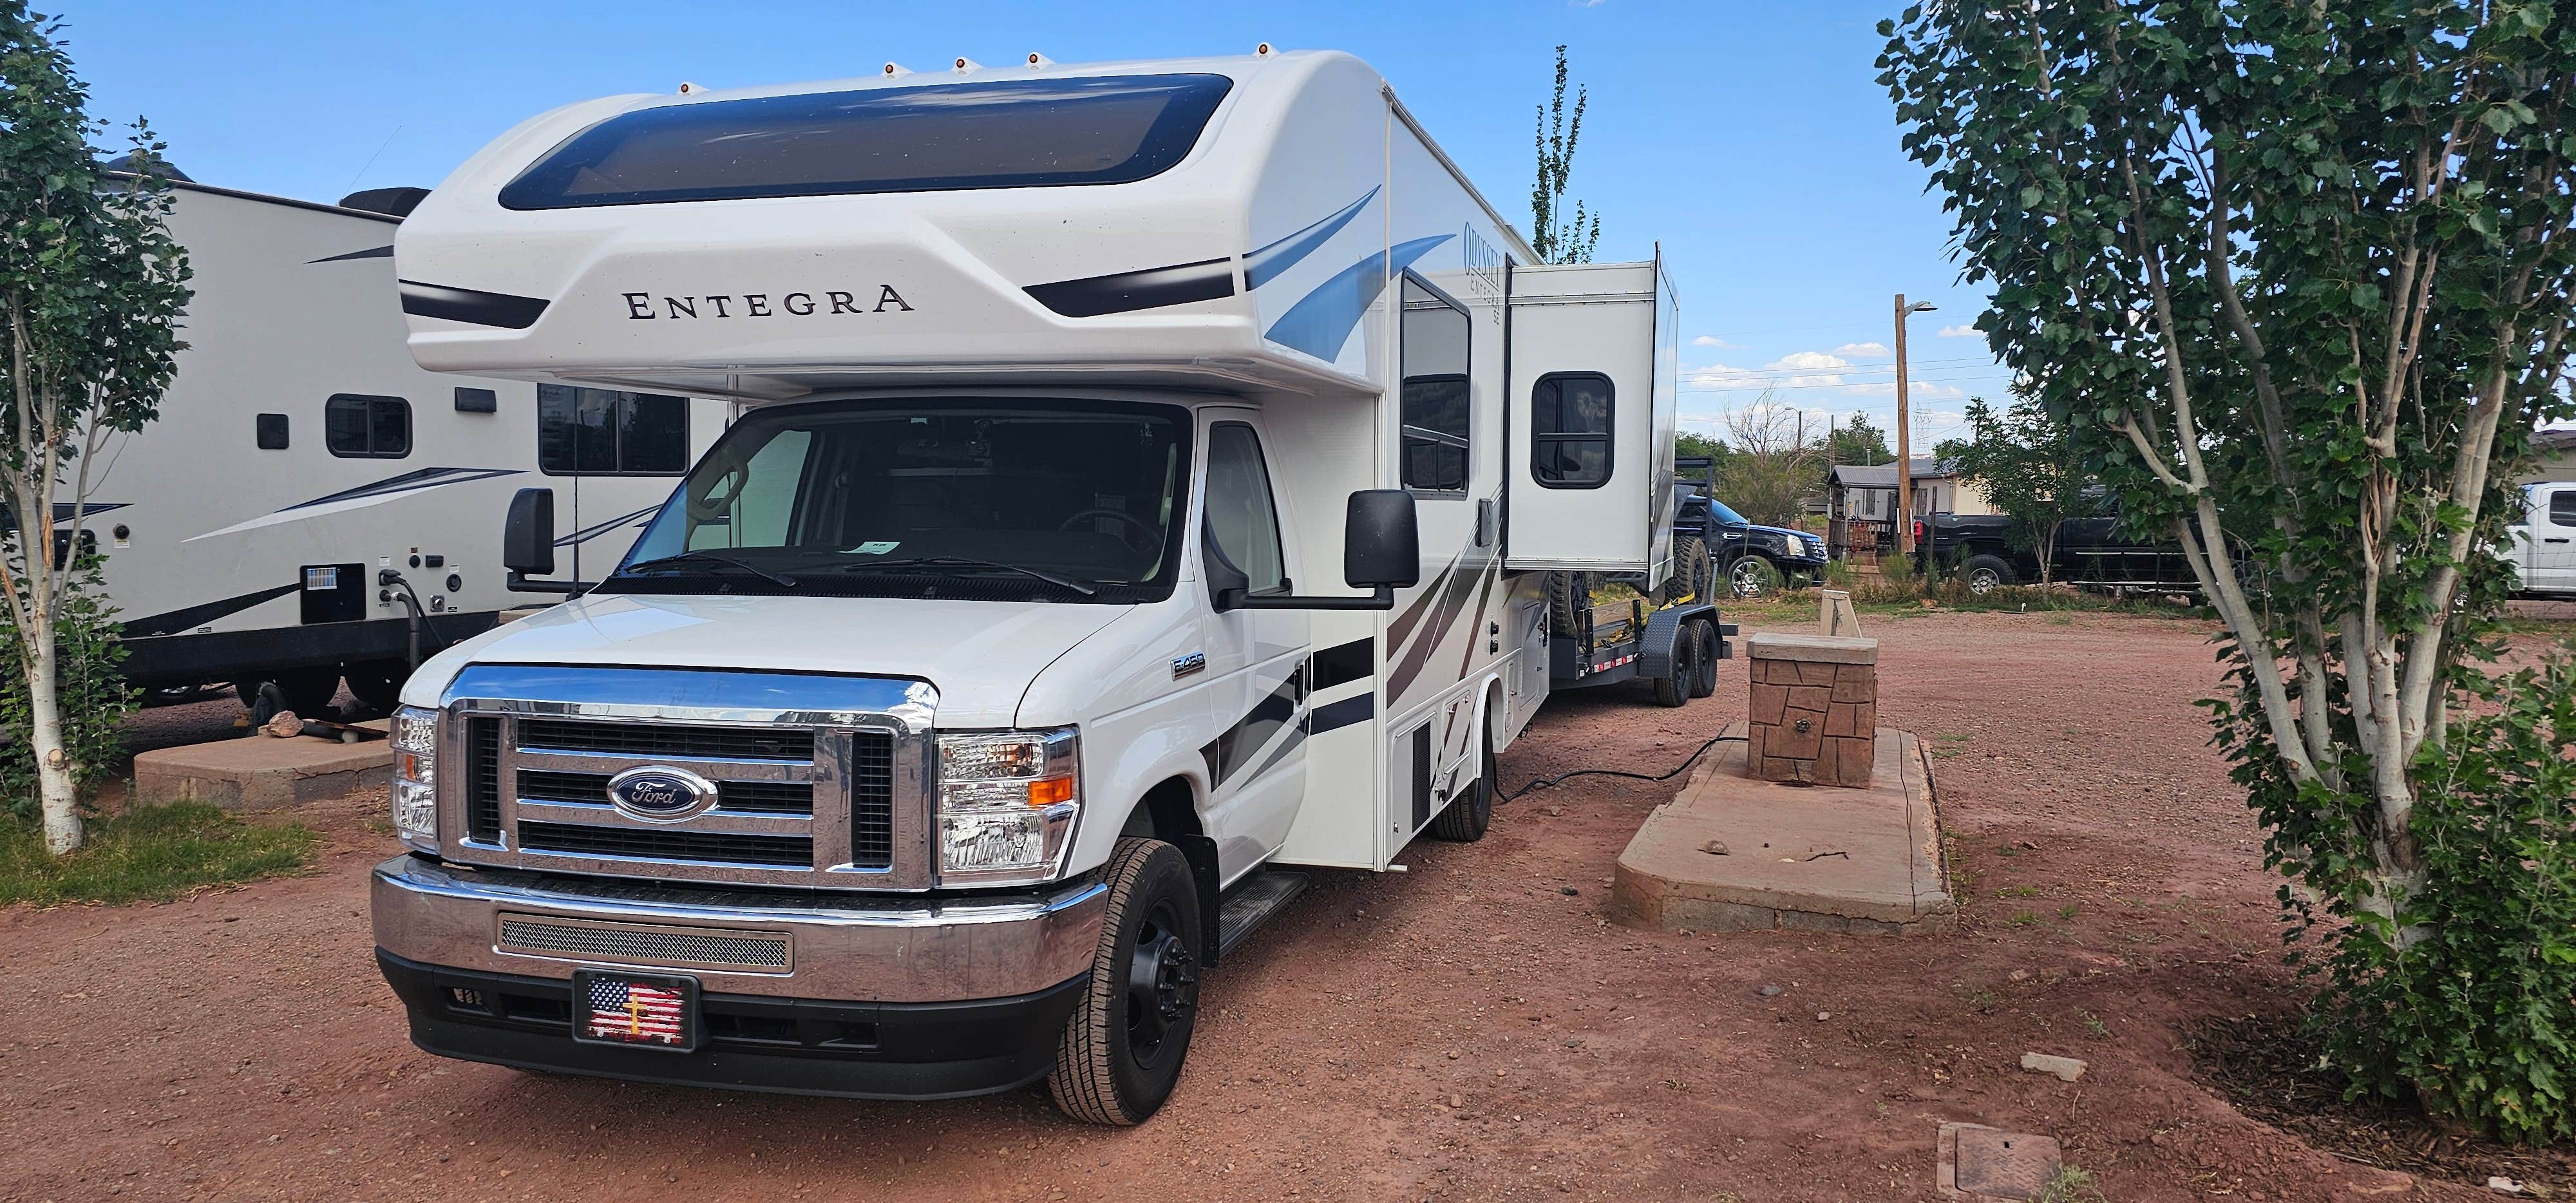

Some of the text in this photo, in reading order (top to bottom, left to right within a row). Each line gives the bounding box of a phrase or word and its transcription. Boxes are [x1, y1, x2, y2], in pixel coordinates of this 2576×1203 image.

[1464, 221, 1501, 287] ODYSSEY
[621, 284, 915, 319] ENTEGRA
[1471, 272, 1500, 311] ENTEGRA
[631, 781, 677, 804] Ford
